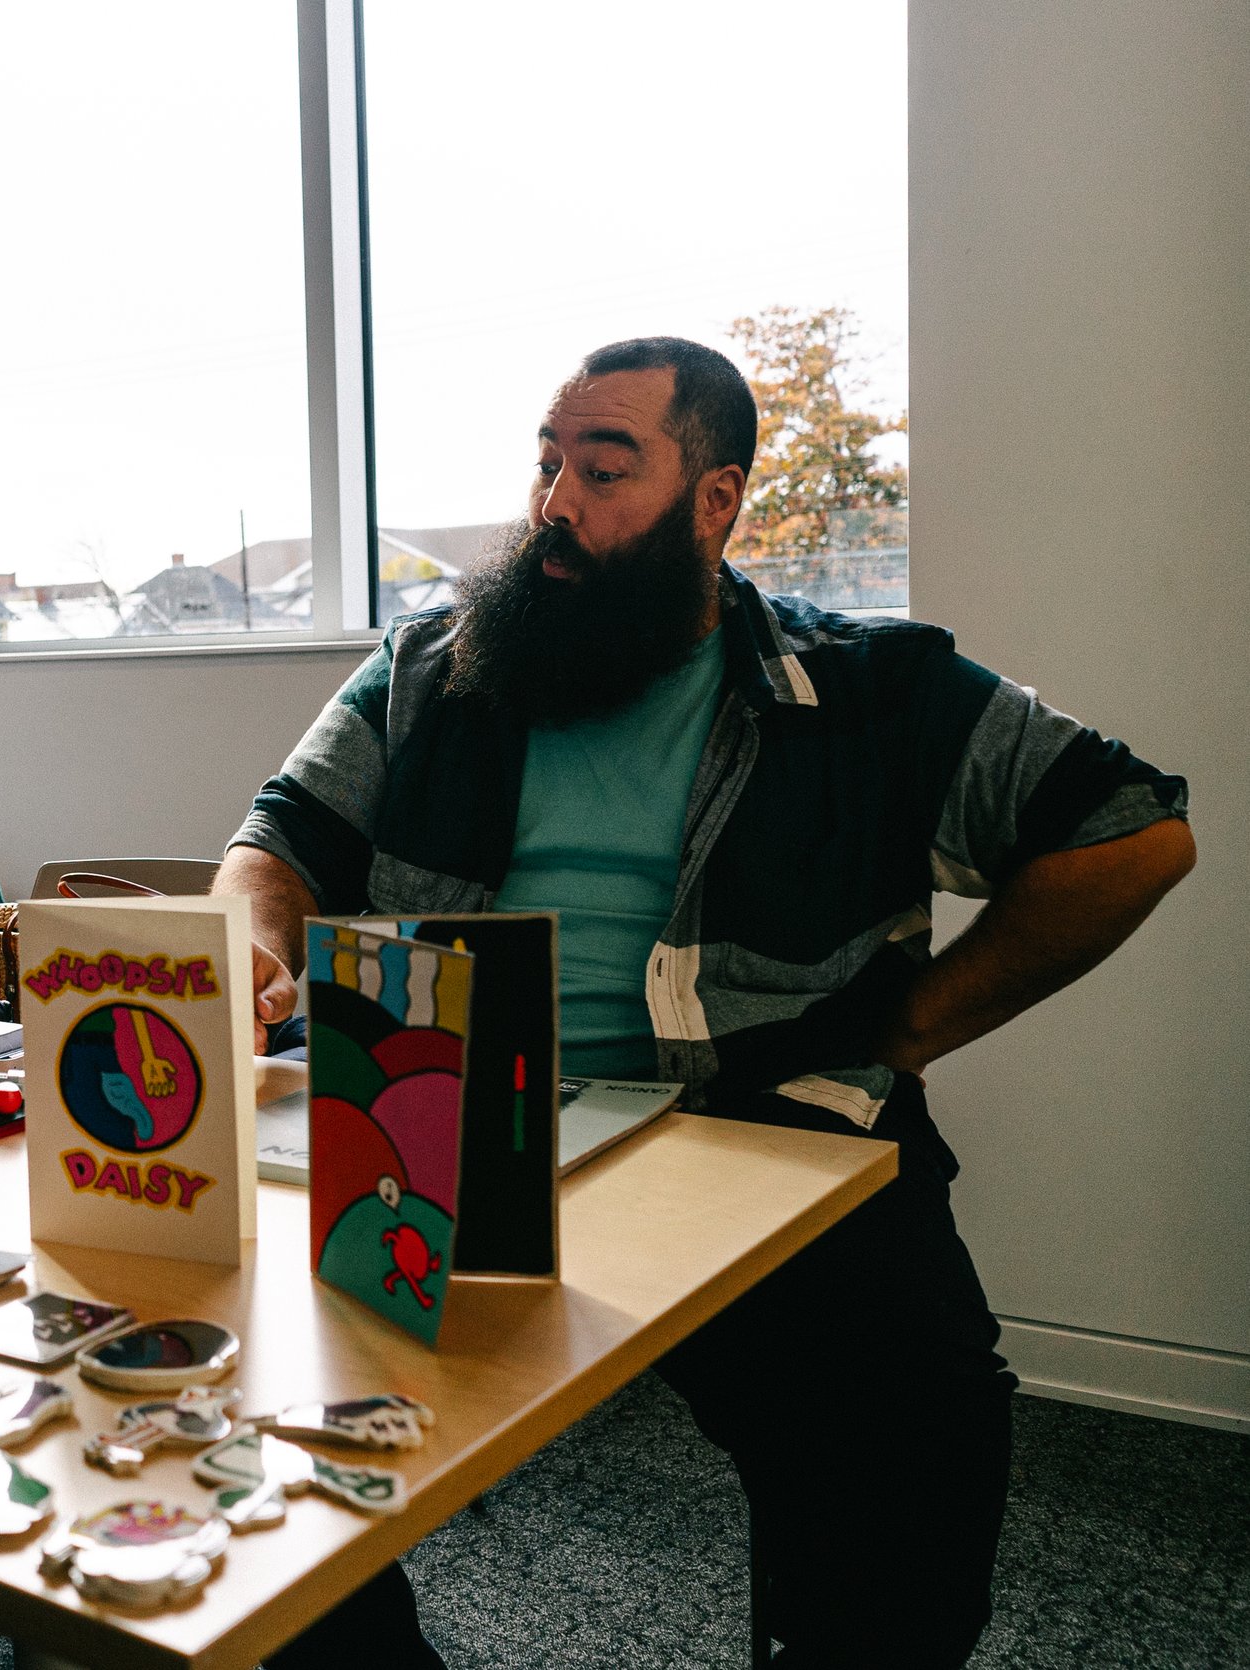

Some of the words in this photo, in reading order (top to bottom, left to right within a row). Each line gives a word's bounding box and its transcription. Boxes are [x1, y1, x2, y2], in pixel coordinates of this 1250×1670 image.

[25, 951, 217, 1000] WHOOPSIE
[603, 1083, 671, 1096] CANSON
[63, 1150, 211, 1211] DAISY
